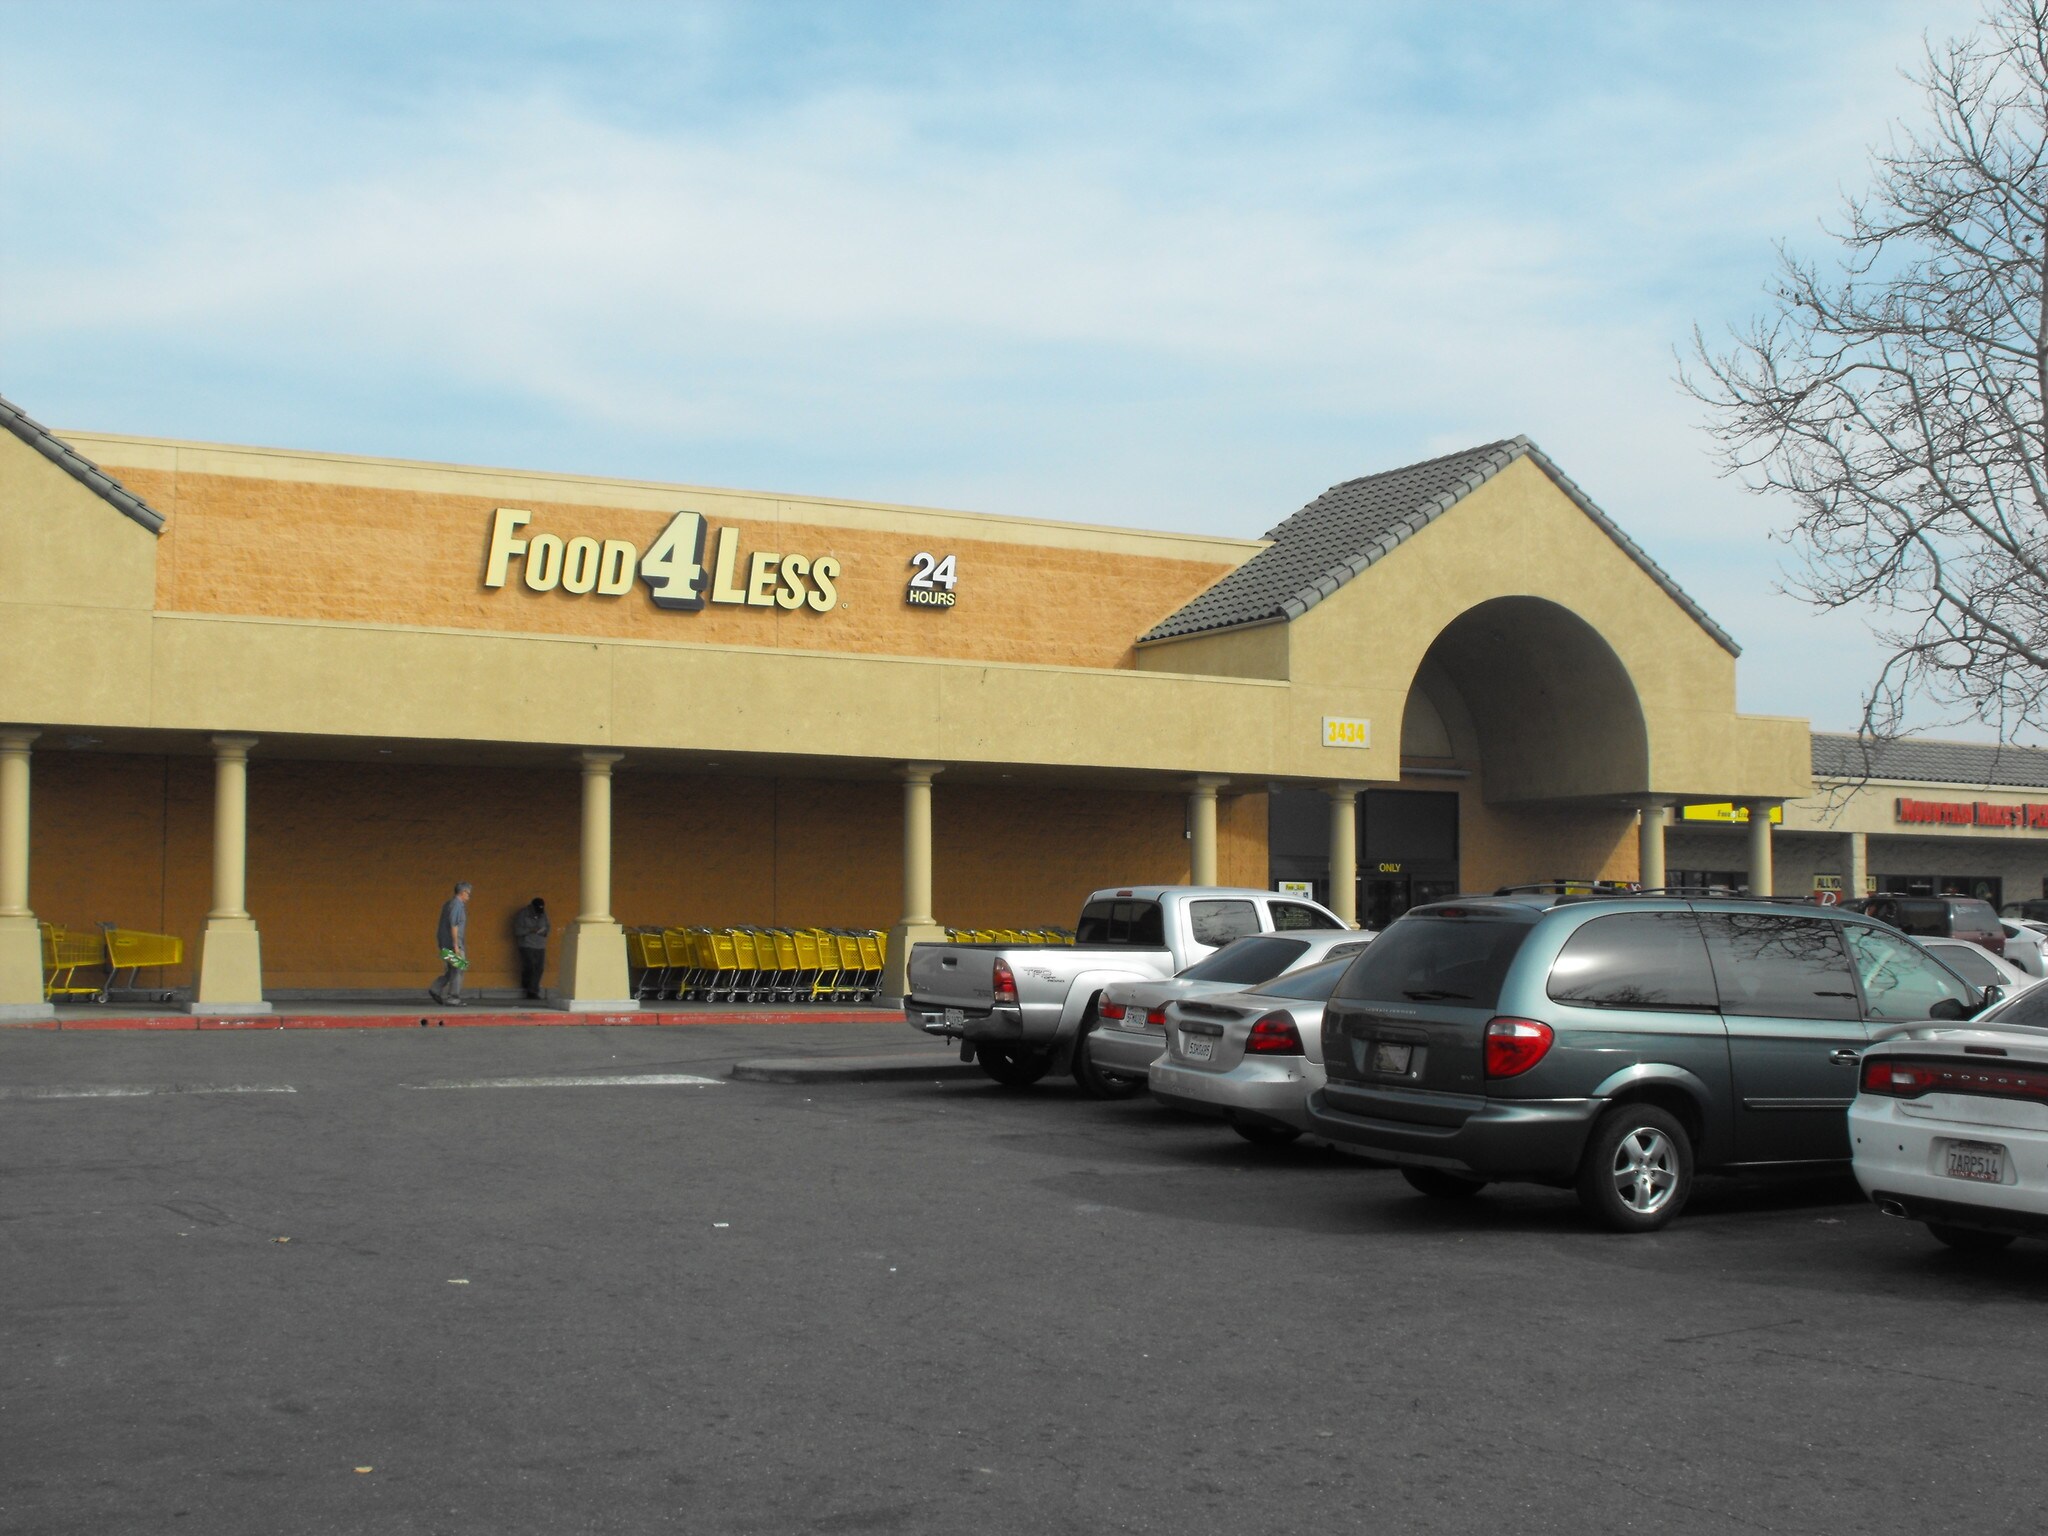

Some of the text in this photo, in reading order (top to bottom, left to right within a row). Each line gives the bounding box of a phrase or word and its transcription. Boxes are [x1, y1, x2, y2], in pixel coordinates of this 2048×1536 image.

[640, 511, 708, 611] 4
[911, 552, 958, 589] 24
[909, 590, 956, 606] HOURS
[1327, 721, 1366, 743] 3434
[1379, 862, 1401, 873] ONLY
[1943, 1073, 2027, 1086] DODGE
[1950, 1153, 1999, 1176] 7ARP514
